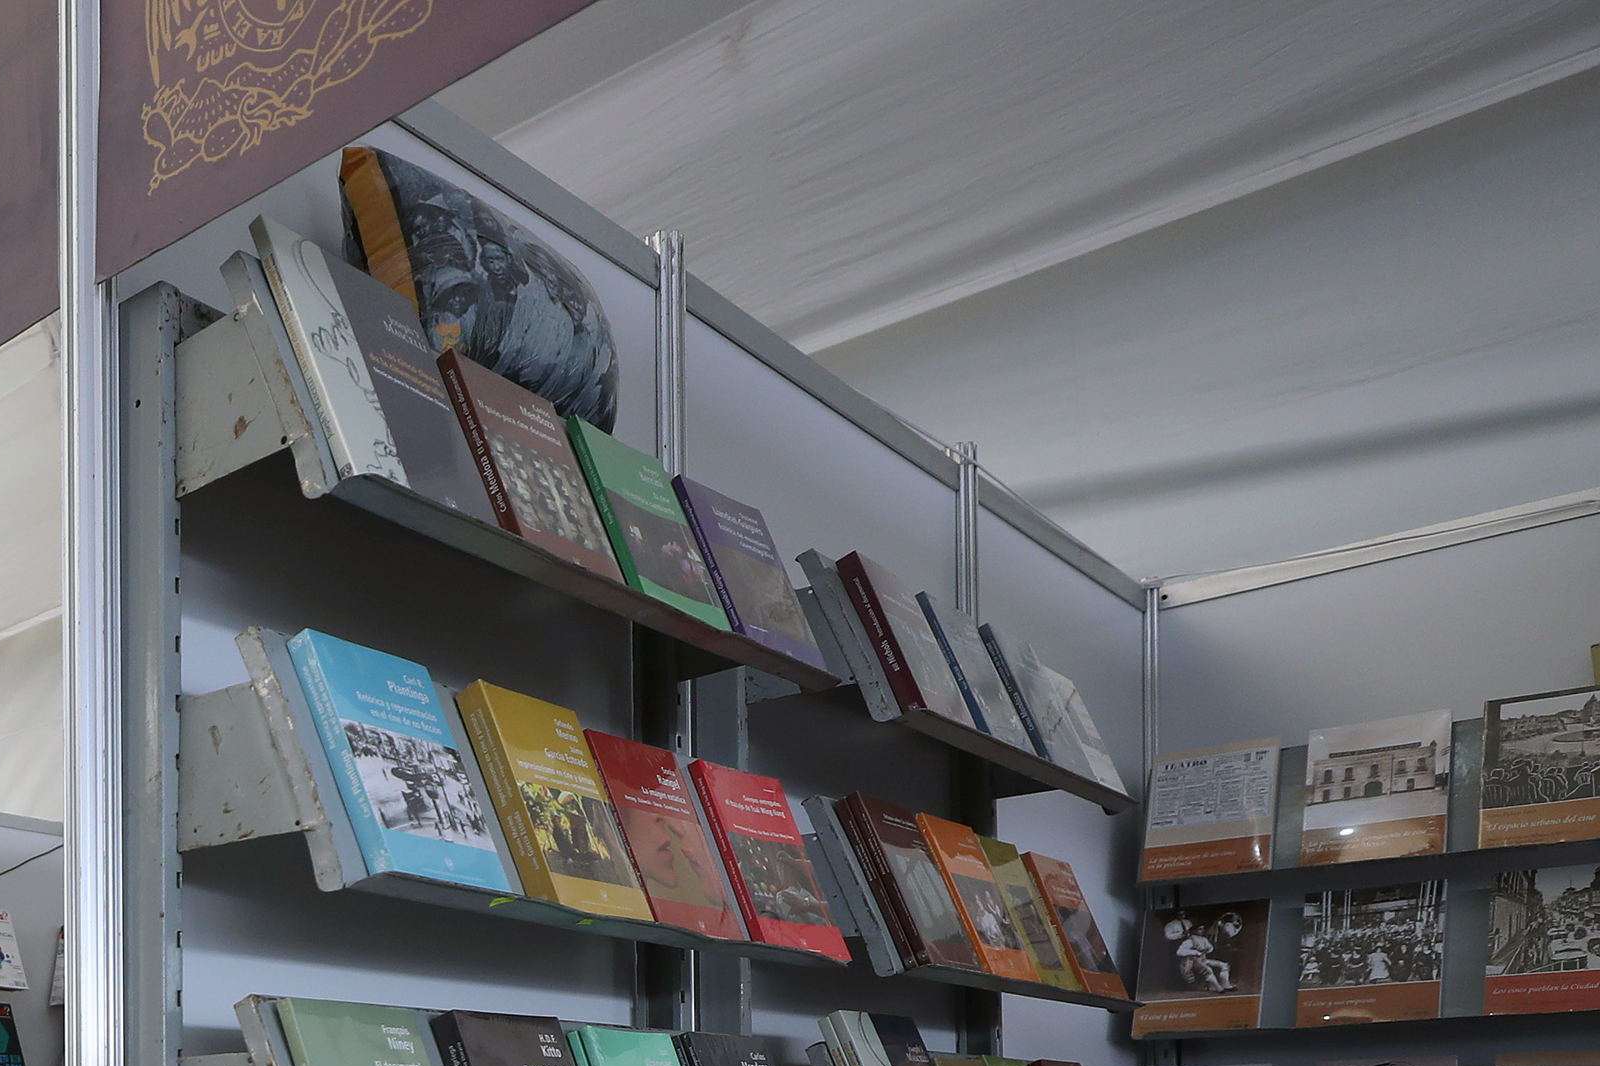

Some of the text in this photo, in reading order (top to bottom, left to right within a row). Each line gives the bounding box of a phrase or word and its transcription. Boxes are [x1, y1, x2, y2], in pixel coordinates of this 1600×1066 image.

[519, 405, 555, 431] Mendoza
[532, 404, 551, 418] Carlos
[403, 675, 416, 686] Carl
[387, 681, 429, 704] Plantinga
[356, 691, 385, 707] Retórica
[391, 701, 438, 722] representación
[555, 728, 578, 744] Merino
[565, 754, 589, 768] Estrada
[661, 767, 675, 777] Sonia
[656, 774, 680, 790] Rangel
[1496, 821, 1526, 833] espacio
[1529, 817, 1559, 831] urbano
[1562, 816, 1576, 826] del
[1579, 814, 1596, 824] cine
[1492, 986, 1503, 994] Los
[1505, 985, 1525, 994] cines
[1527, 982, 1559, 994] pueblan
[1571, 981, 1600, 991] Ciudad
[381, 1025, 409, 1037] François
[387, 1037, 415, 1053] Niney
[538, 1034, 558, 1044] H.D.F.
[540, 1045, 562, 1058] Kitto
[750, 1052, 766, 1061] Carlos
